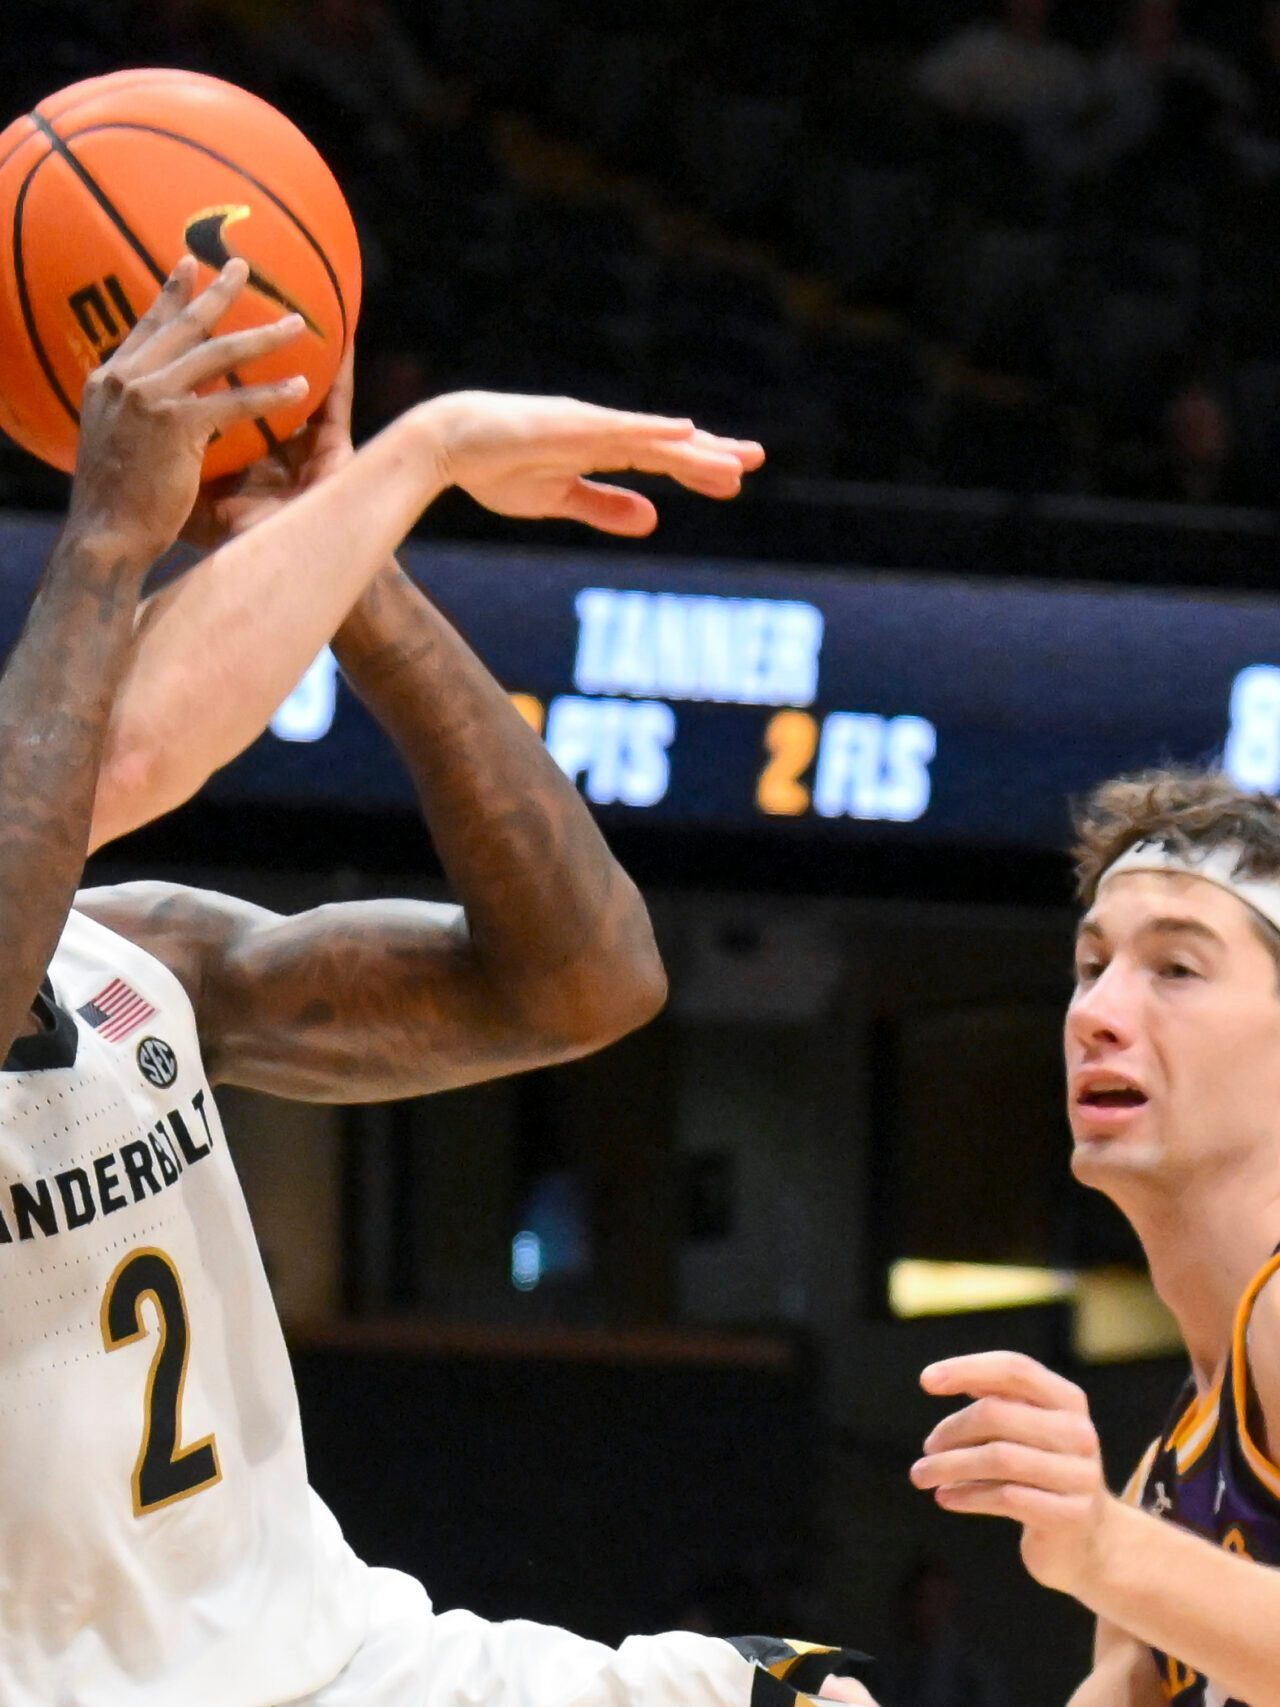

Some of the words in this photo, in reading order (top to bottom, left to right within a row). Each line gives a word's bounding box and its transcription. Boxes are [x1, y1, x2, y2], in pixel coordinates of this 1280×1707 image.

[574, 587, 825, 708] TANNER
[546, 694, 676, 808] PTS
[757, 709, 819, 817] 2
[813, 711, 937, 822] FLS
[139, 1038, 176, 1086] SEC
[100, 1246, 223, 1519] 2
